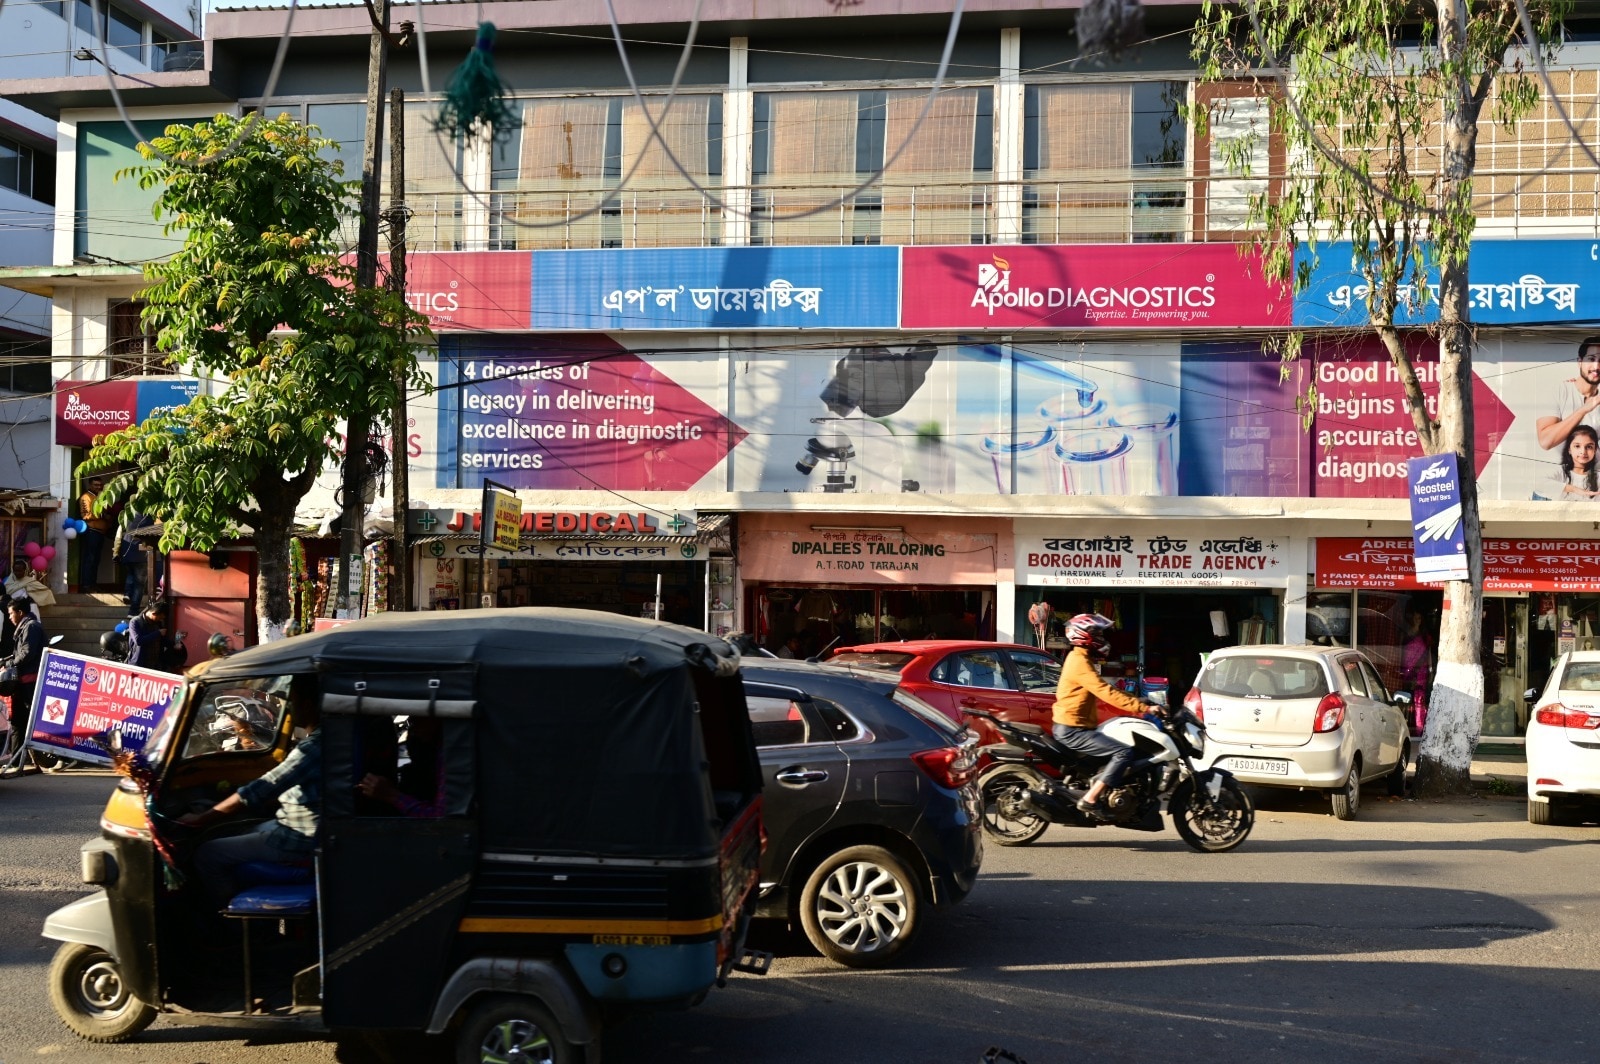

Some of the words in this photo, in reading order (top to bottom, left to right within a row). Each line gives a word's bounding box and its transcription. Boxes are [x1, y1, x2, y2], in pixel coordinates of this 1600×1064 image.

[971, 287, 1044, 315] Apollo
[1047, 287, 1216, 307] DIAGNOSTICS
[1084, 308, 1128, 321] Expertise.
[1131, 309, 1188, 320] Empowering
[1191, 311, 1210, 321] you.
[464, 362, 476, 379] 4
[482, 360, 564, 380] decades
[569, 362, 590, 380] of
[1320, 361, 1378, 383] Good
[66, 403, 90, 413] Apollo
[463, 389, 527, 413] legacy
[533, 390, 550, 410] in
[556, 390, 655, 414] delivering
[1319, 393, 1395, 420] begins
[64, 410, 130, 420] DIAGNOSTICS
[462, 418, 566, 439] excellence
[572, 419, 590, 439] in
[596, 419, 702, 444] diagnostic
[1318, 427, 1417, 447] accurate
[461, 448, 543, 469] services
[1414, 480, 1454, 495] Neosteel
[867, 542, 945, 556] TAILORING
[1028, 554, 1122, 568] BORGOHAIN
[1137, 555, 1192, 569] TRADE
[1202, 556, 1267, 570] AGENCY
[98, 670, 116, 694] NO
[117, 674, 169, 706] PARKING
[110, 702, 122, 713] BY
[124, 706, 154, 720] ORDER
[76, 712, 110, 732] JORHAT
[112, 718, 146, 741] TRAFFIC
[1234, 760, 1286, 772] AS03AA7895
